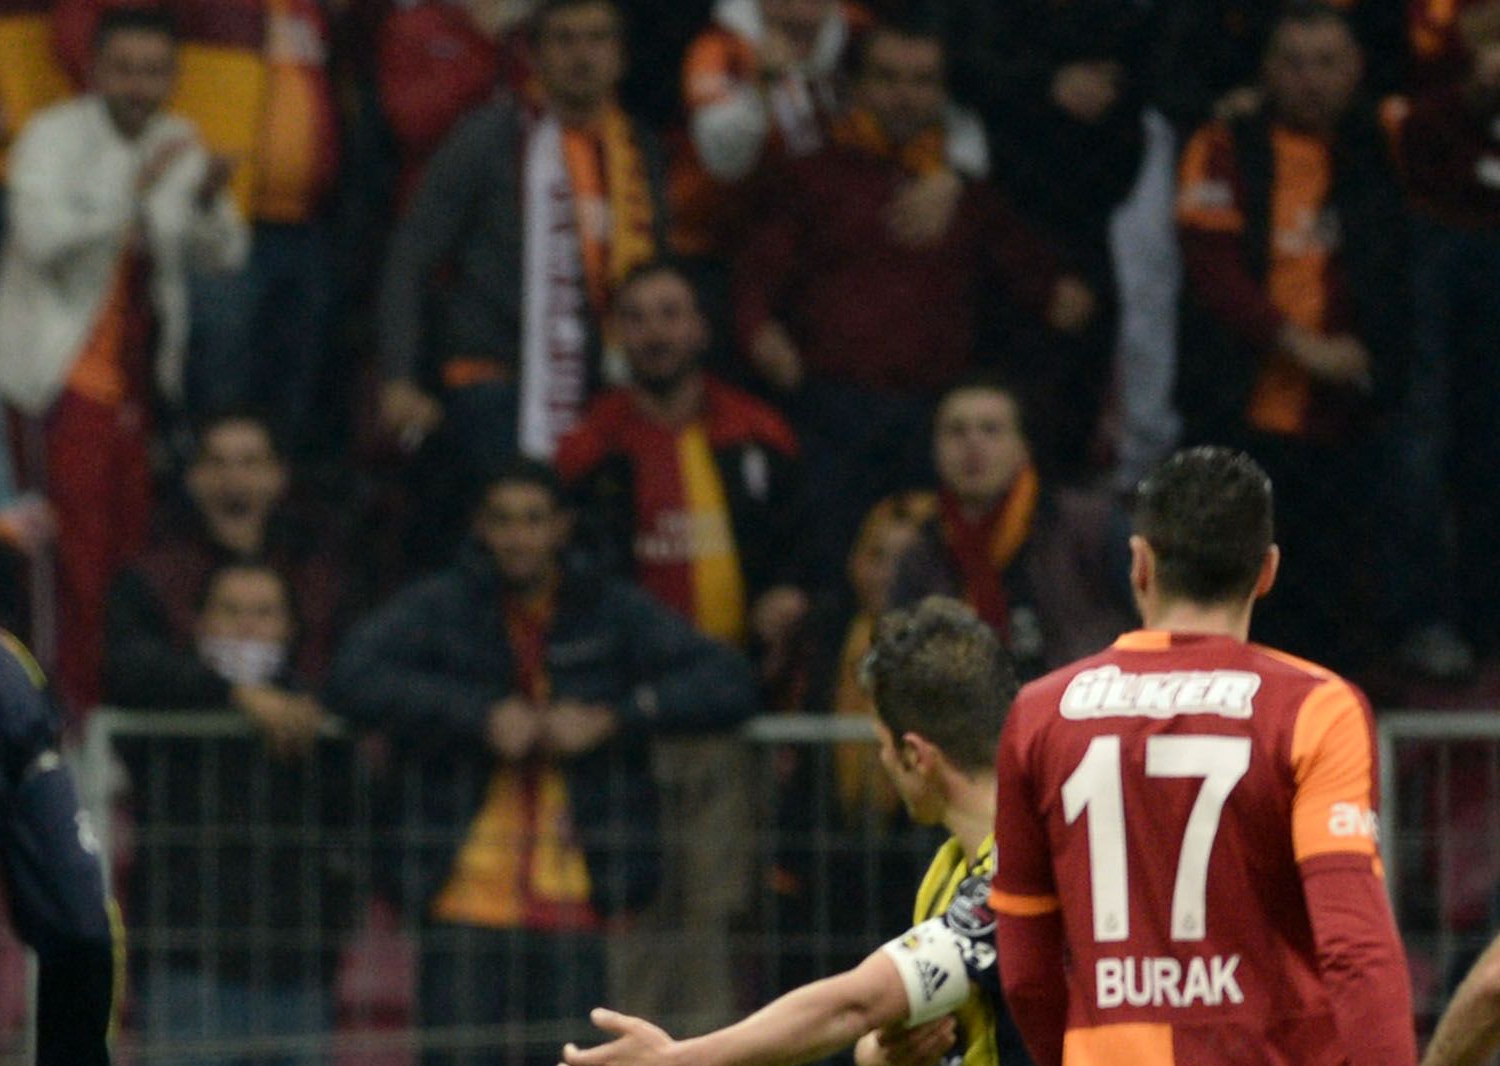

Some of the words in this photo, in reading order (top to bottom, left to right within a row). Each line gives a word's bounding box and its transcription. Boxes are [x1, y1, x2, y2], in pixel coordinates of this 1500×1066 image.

[1060, 665, 1261, 720] ÜLKER
[1060, 734, 1252, 943] 17
[1096, 954, 1244, 1009] BURAK
